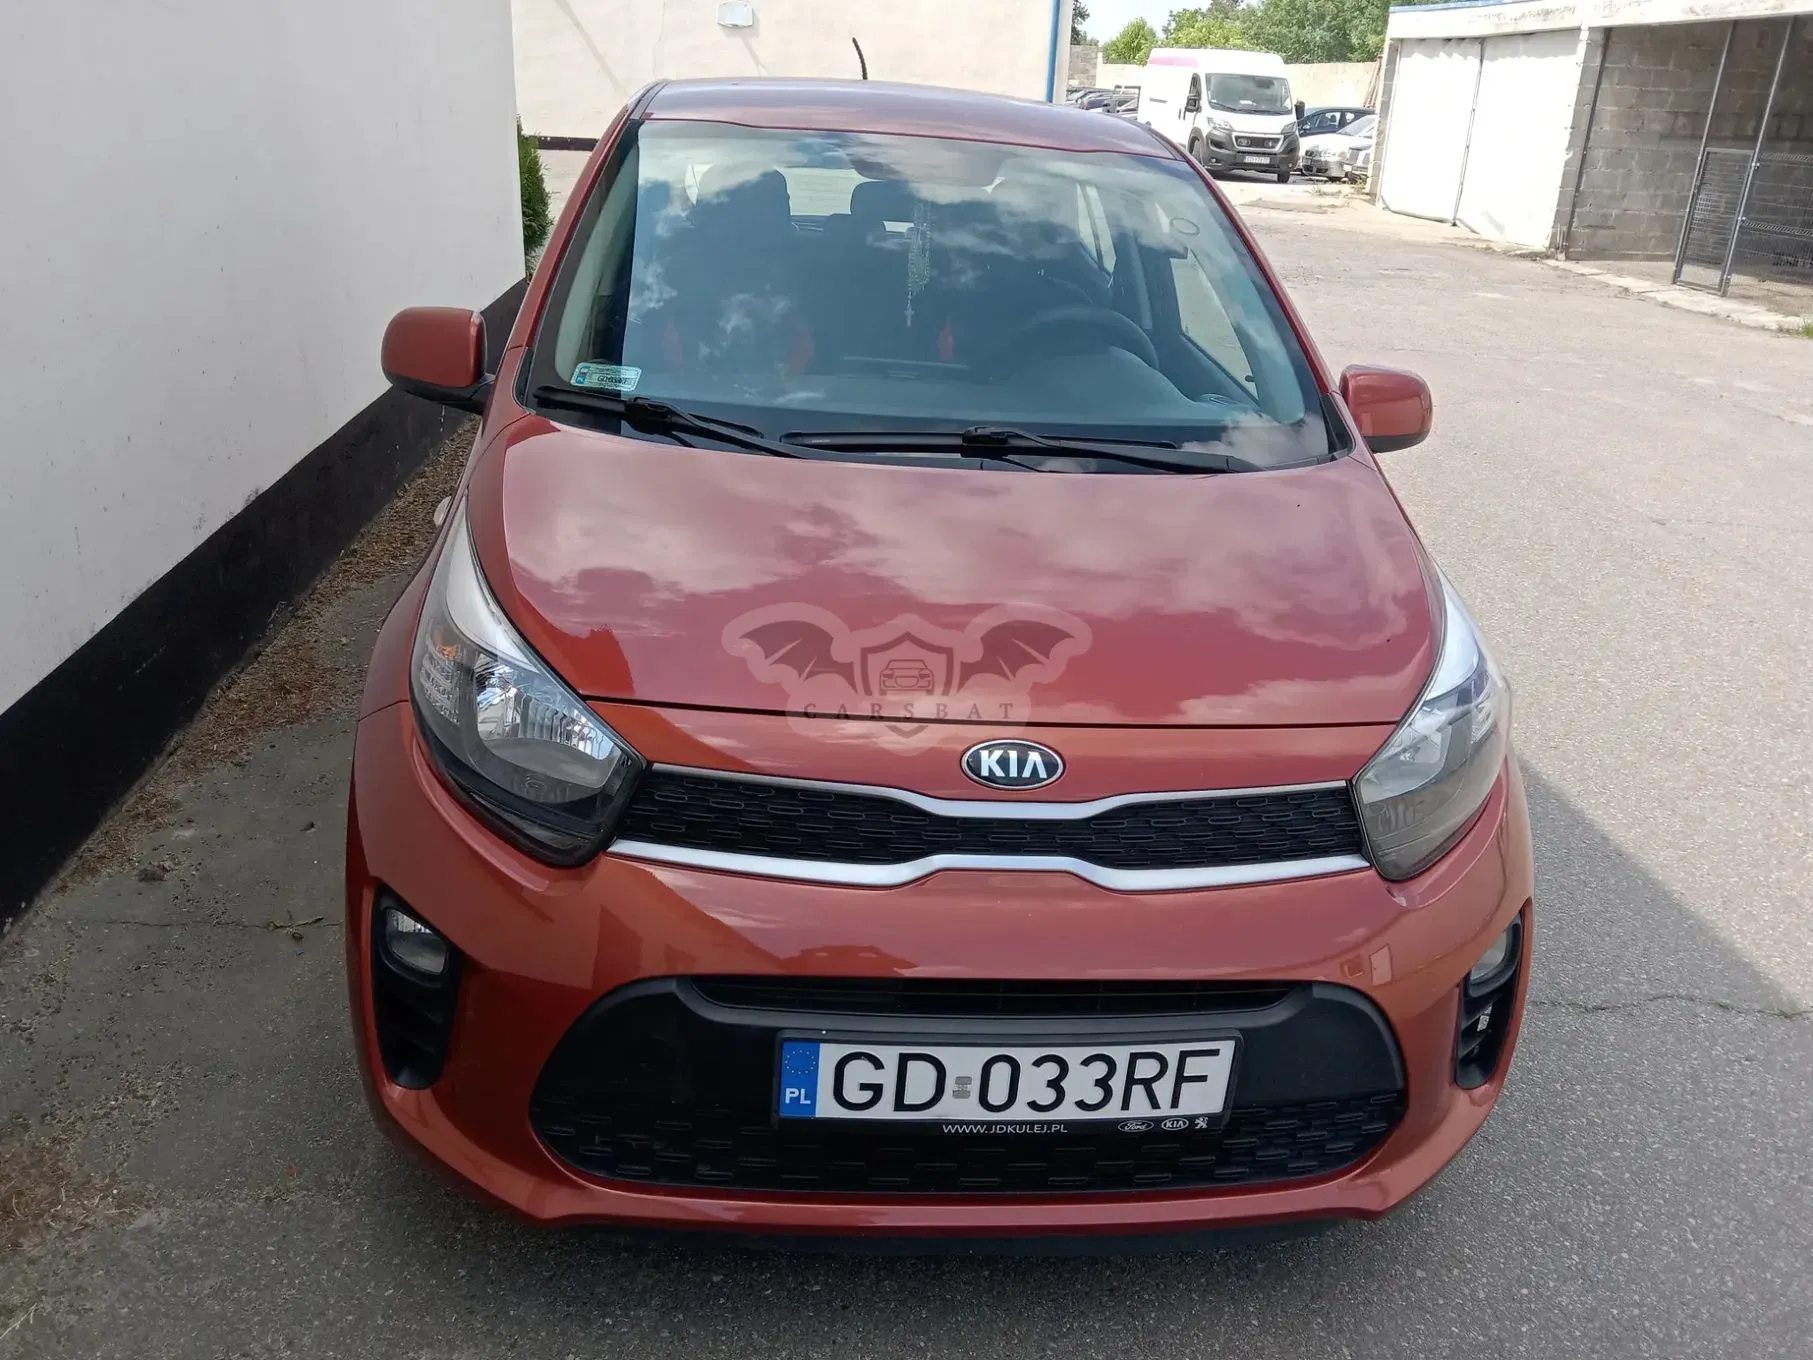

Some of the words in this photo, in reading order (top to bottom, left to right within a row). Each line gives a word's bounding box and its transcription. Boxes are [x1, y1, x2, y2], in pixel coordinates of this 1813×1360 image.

[979, 749, 1048, 779] KIA
[832, 1051, 947, 1113] GD
[978, 1048, 1221, 1113] 033RF
[784, 1087, 812, 1105] PL
[942, 1124, 1068, 1134] WWW.JDKULEJ.PL
